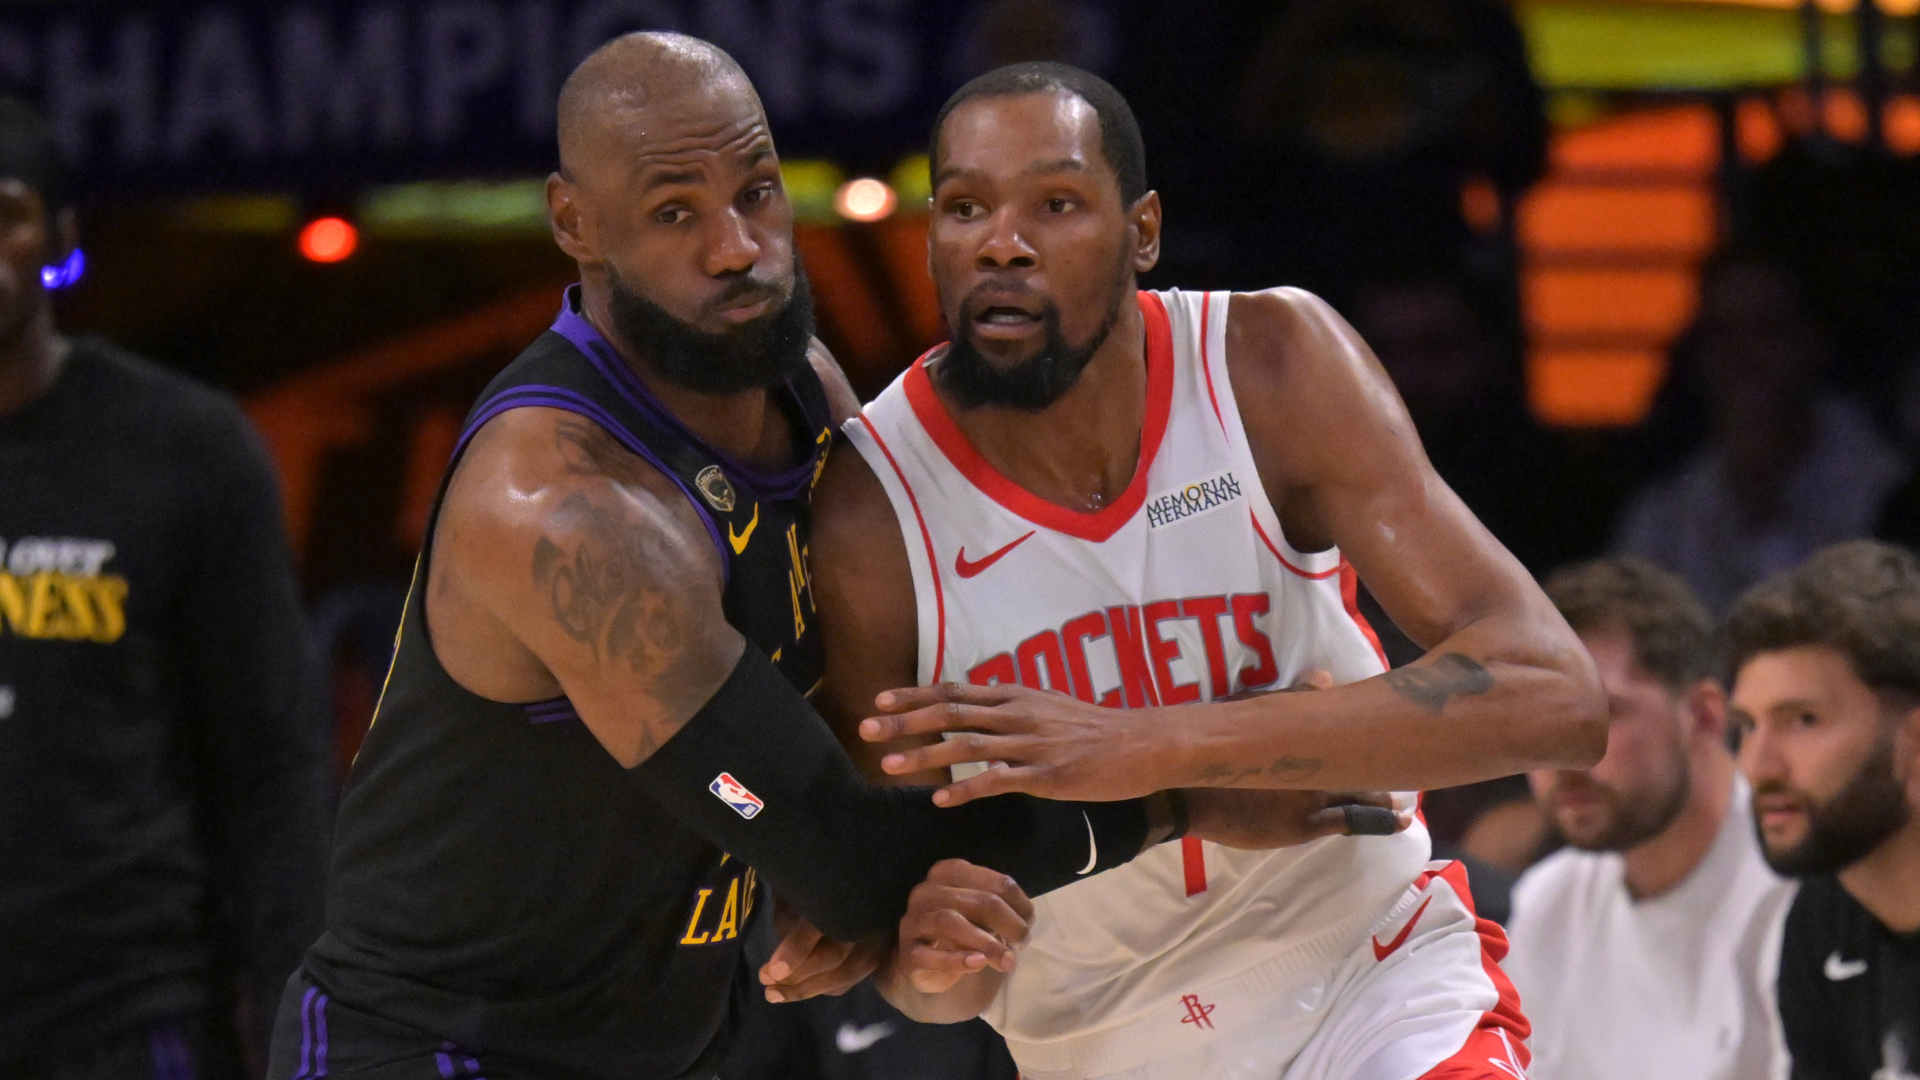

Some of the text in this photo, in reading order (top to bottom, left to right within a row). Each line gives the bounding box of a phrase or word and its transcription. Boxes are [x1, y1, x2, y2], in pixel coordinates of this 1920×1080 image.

[0, 0, 915, 168] HAMPINS
[1147, 472, 1240, 514] MEMORIAL
[1148, 484, 1242, 528] HERMANN
